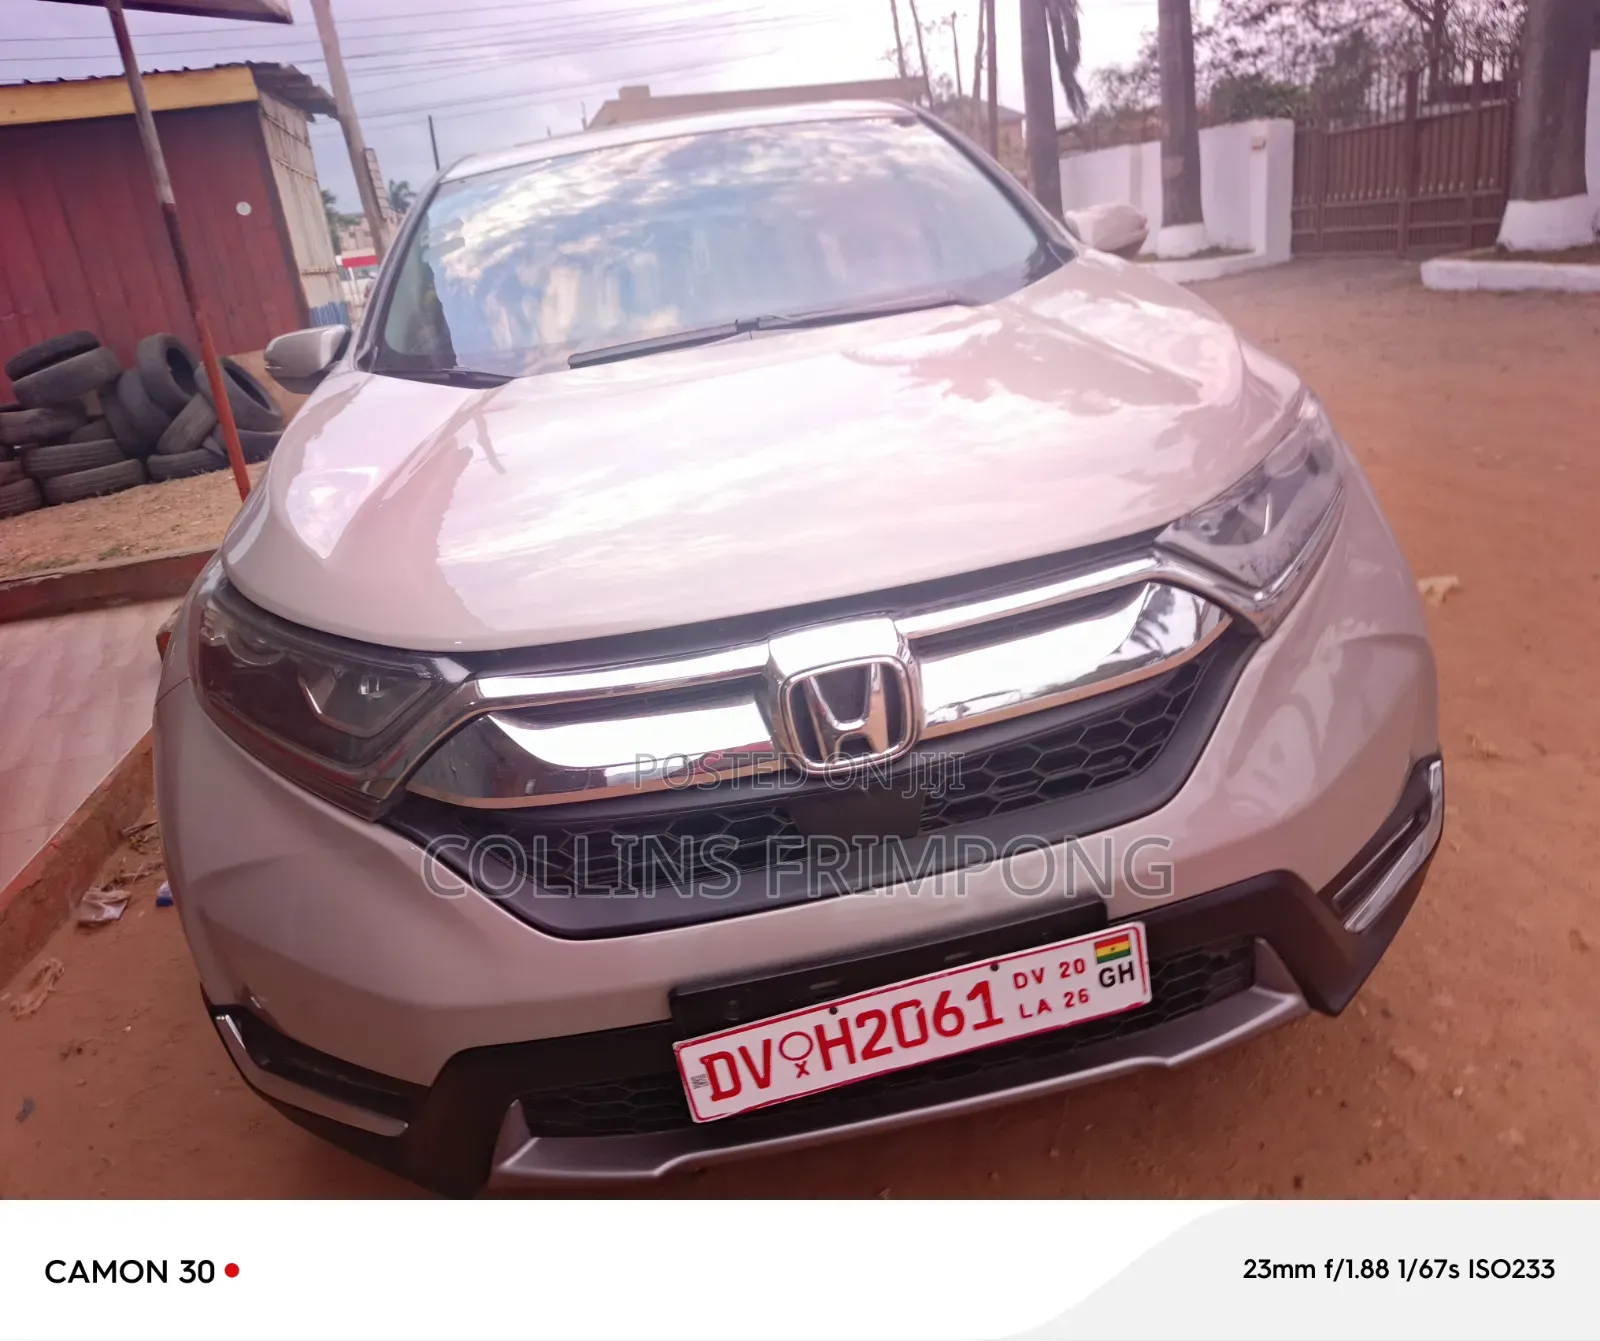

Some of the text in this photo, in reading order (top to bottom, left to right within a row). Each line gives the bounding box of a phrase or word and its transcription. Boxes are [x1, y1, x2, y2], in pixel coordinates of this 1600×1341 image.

[1012, 957, 1086, 990] DV 20
[1099, 961, 1135, 988] GH
[1018, 988, 1090, 1020] LA 26
[699, 979, 1004, 1102] DV H2061
